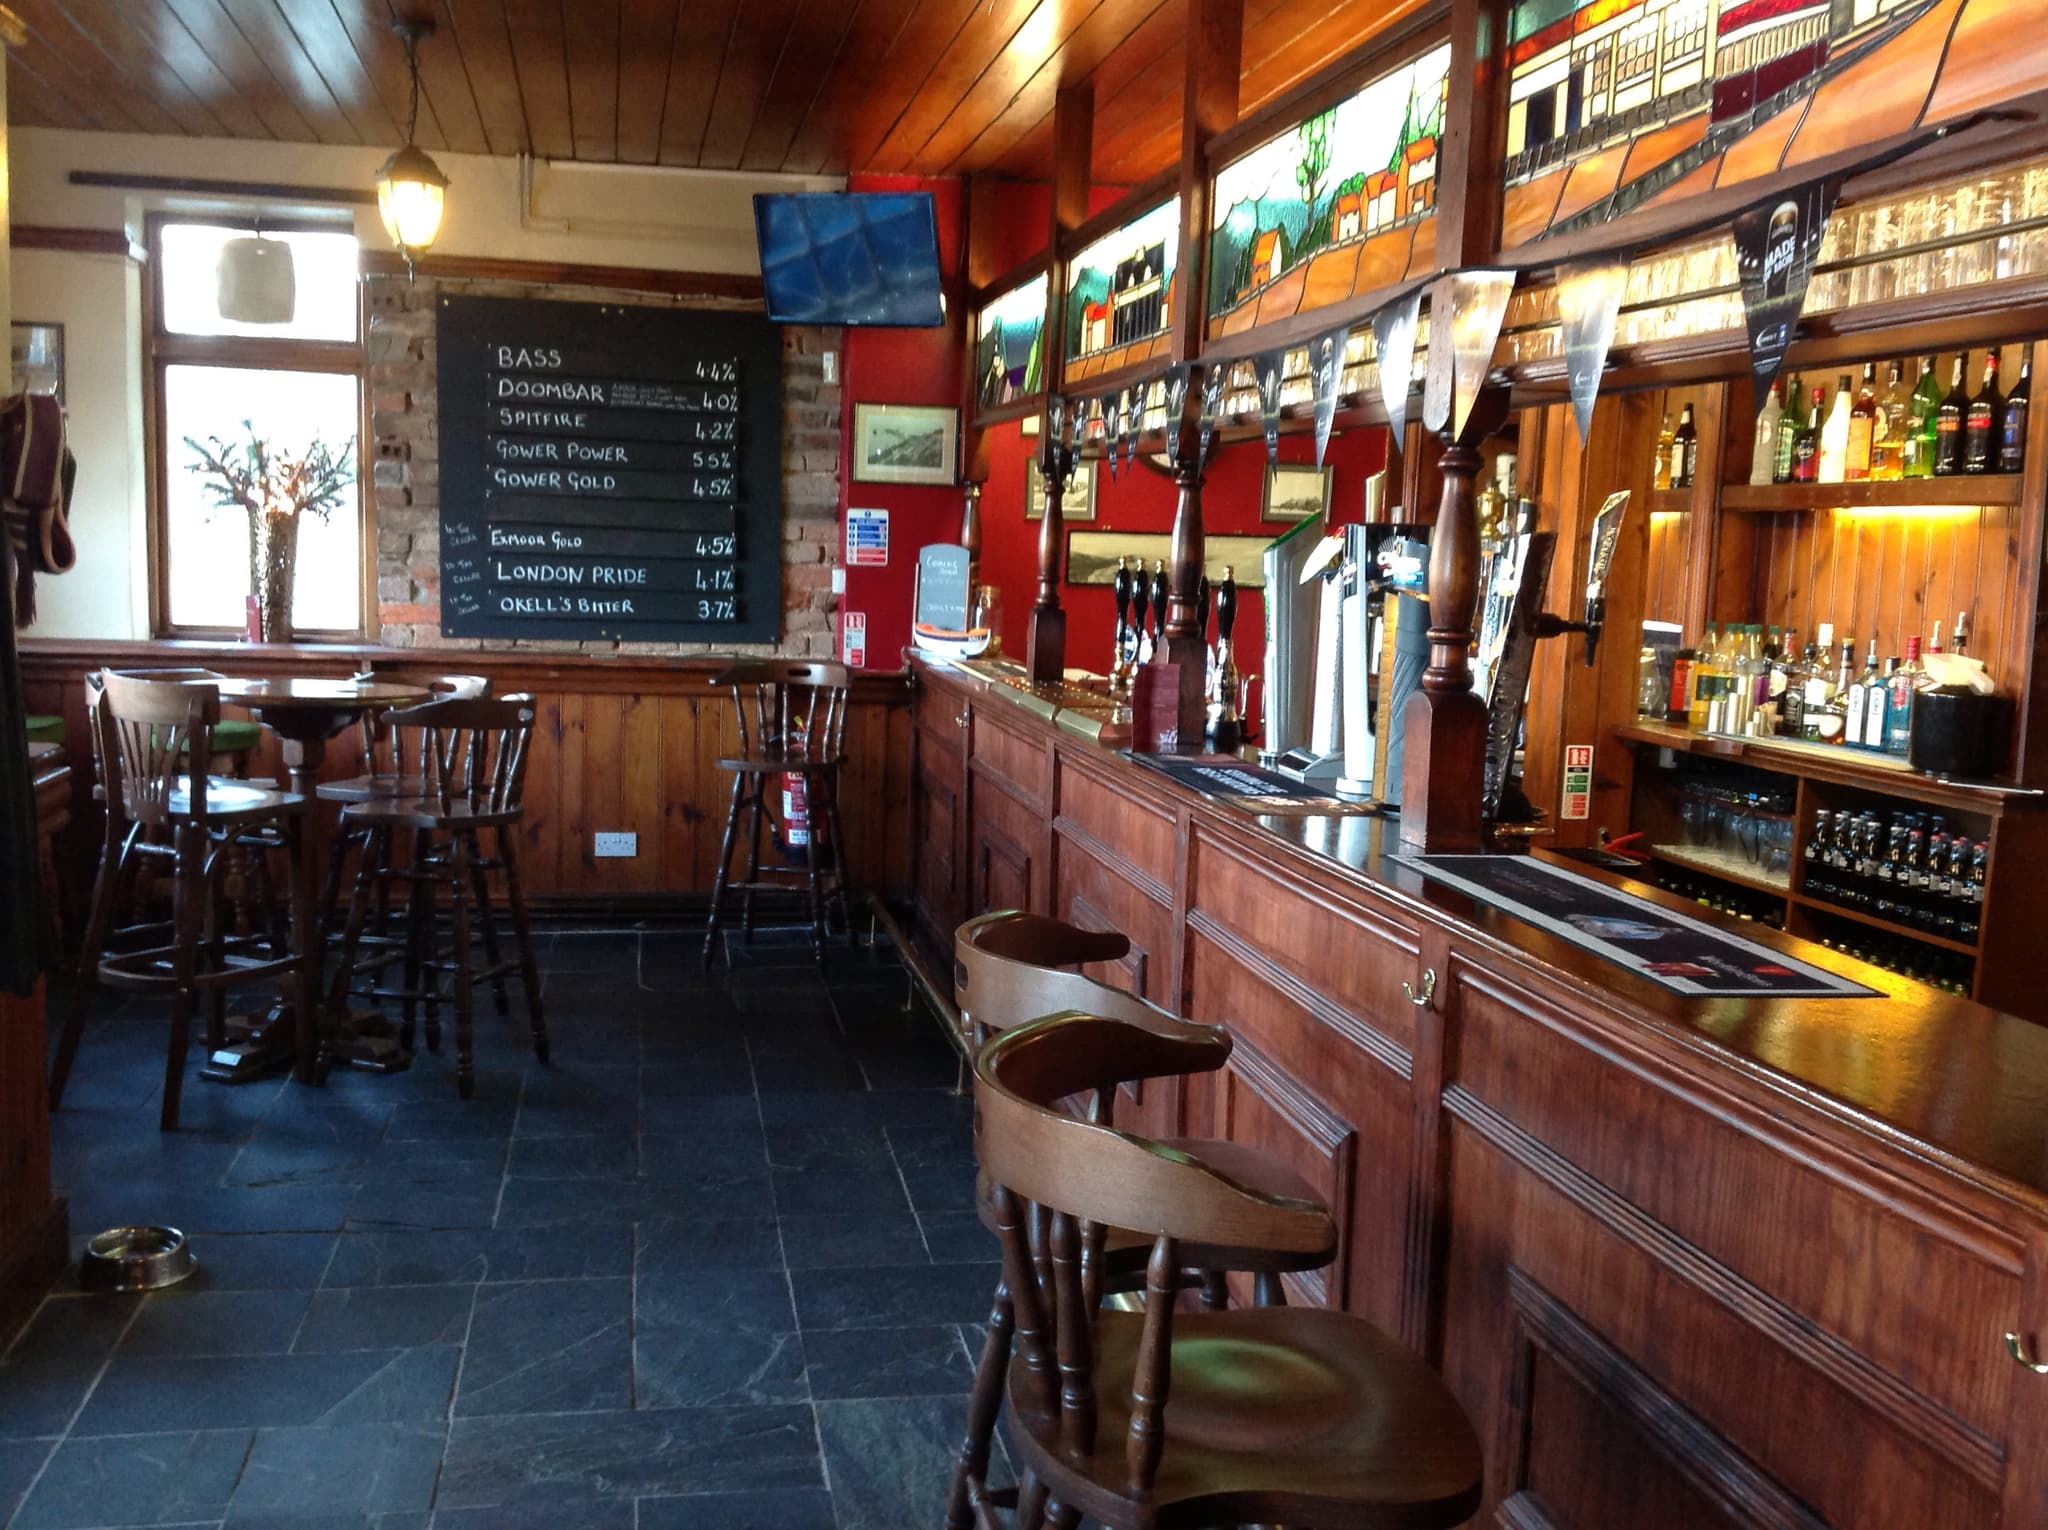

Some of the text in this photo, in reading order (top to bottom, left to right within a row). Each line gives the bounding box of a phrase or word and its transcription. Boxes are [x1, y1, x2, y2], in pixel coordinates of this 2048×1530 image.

[1764, 235, 1796, 272] MADE
[499, 346, 561, 368] BASS
[499, 378, 604, 403] DOOMBAR
[500, 407, 587, 428] SPITFIRE
[497, 439, 628, 463] GOWER POWER
[495, 467, 616, 491] GOWER GOLD
[551, 530, 582, 550] GOLD
[498, 561, 647, 584] LONDON PRIDE
[500, 596, 571, 613] OKELL'S
